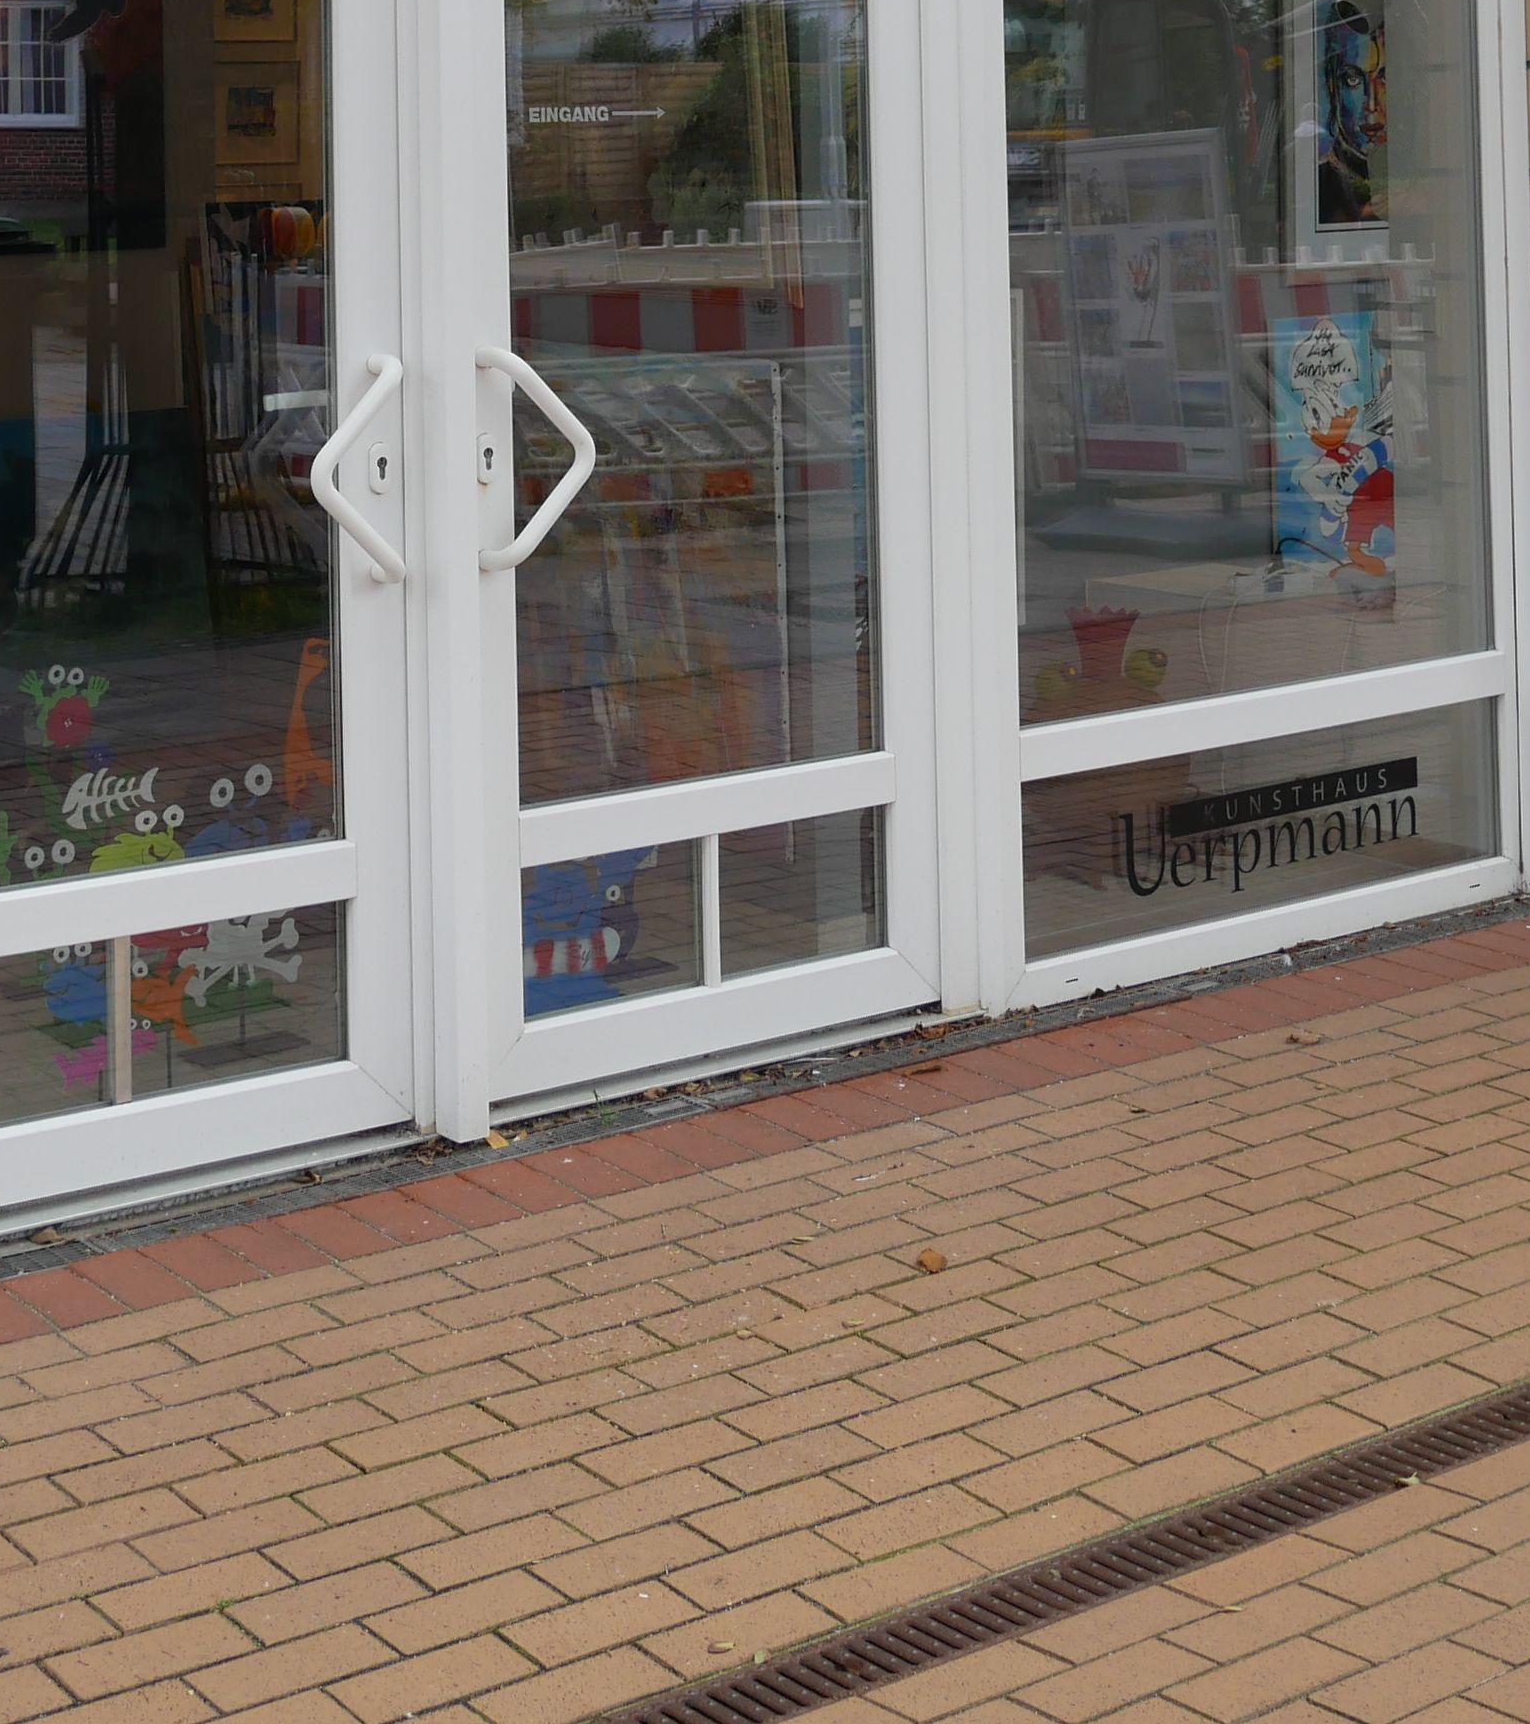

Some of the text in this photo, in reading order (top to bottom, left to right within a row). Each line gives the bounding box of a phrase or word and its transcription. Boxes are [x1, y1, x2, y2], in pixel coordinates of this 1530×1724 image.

[528, 105, 609, 123] EINGANG
[1204, 767, 1388, 824] KUNSTHAUS
[1118, 794, 1420, 898] Uerpmann
